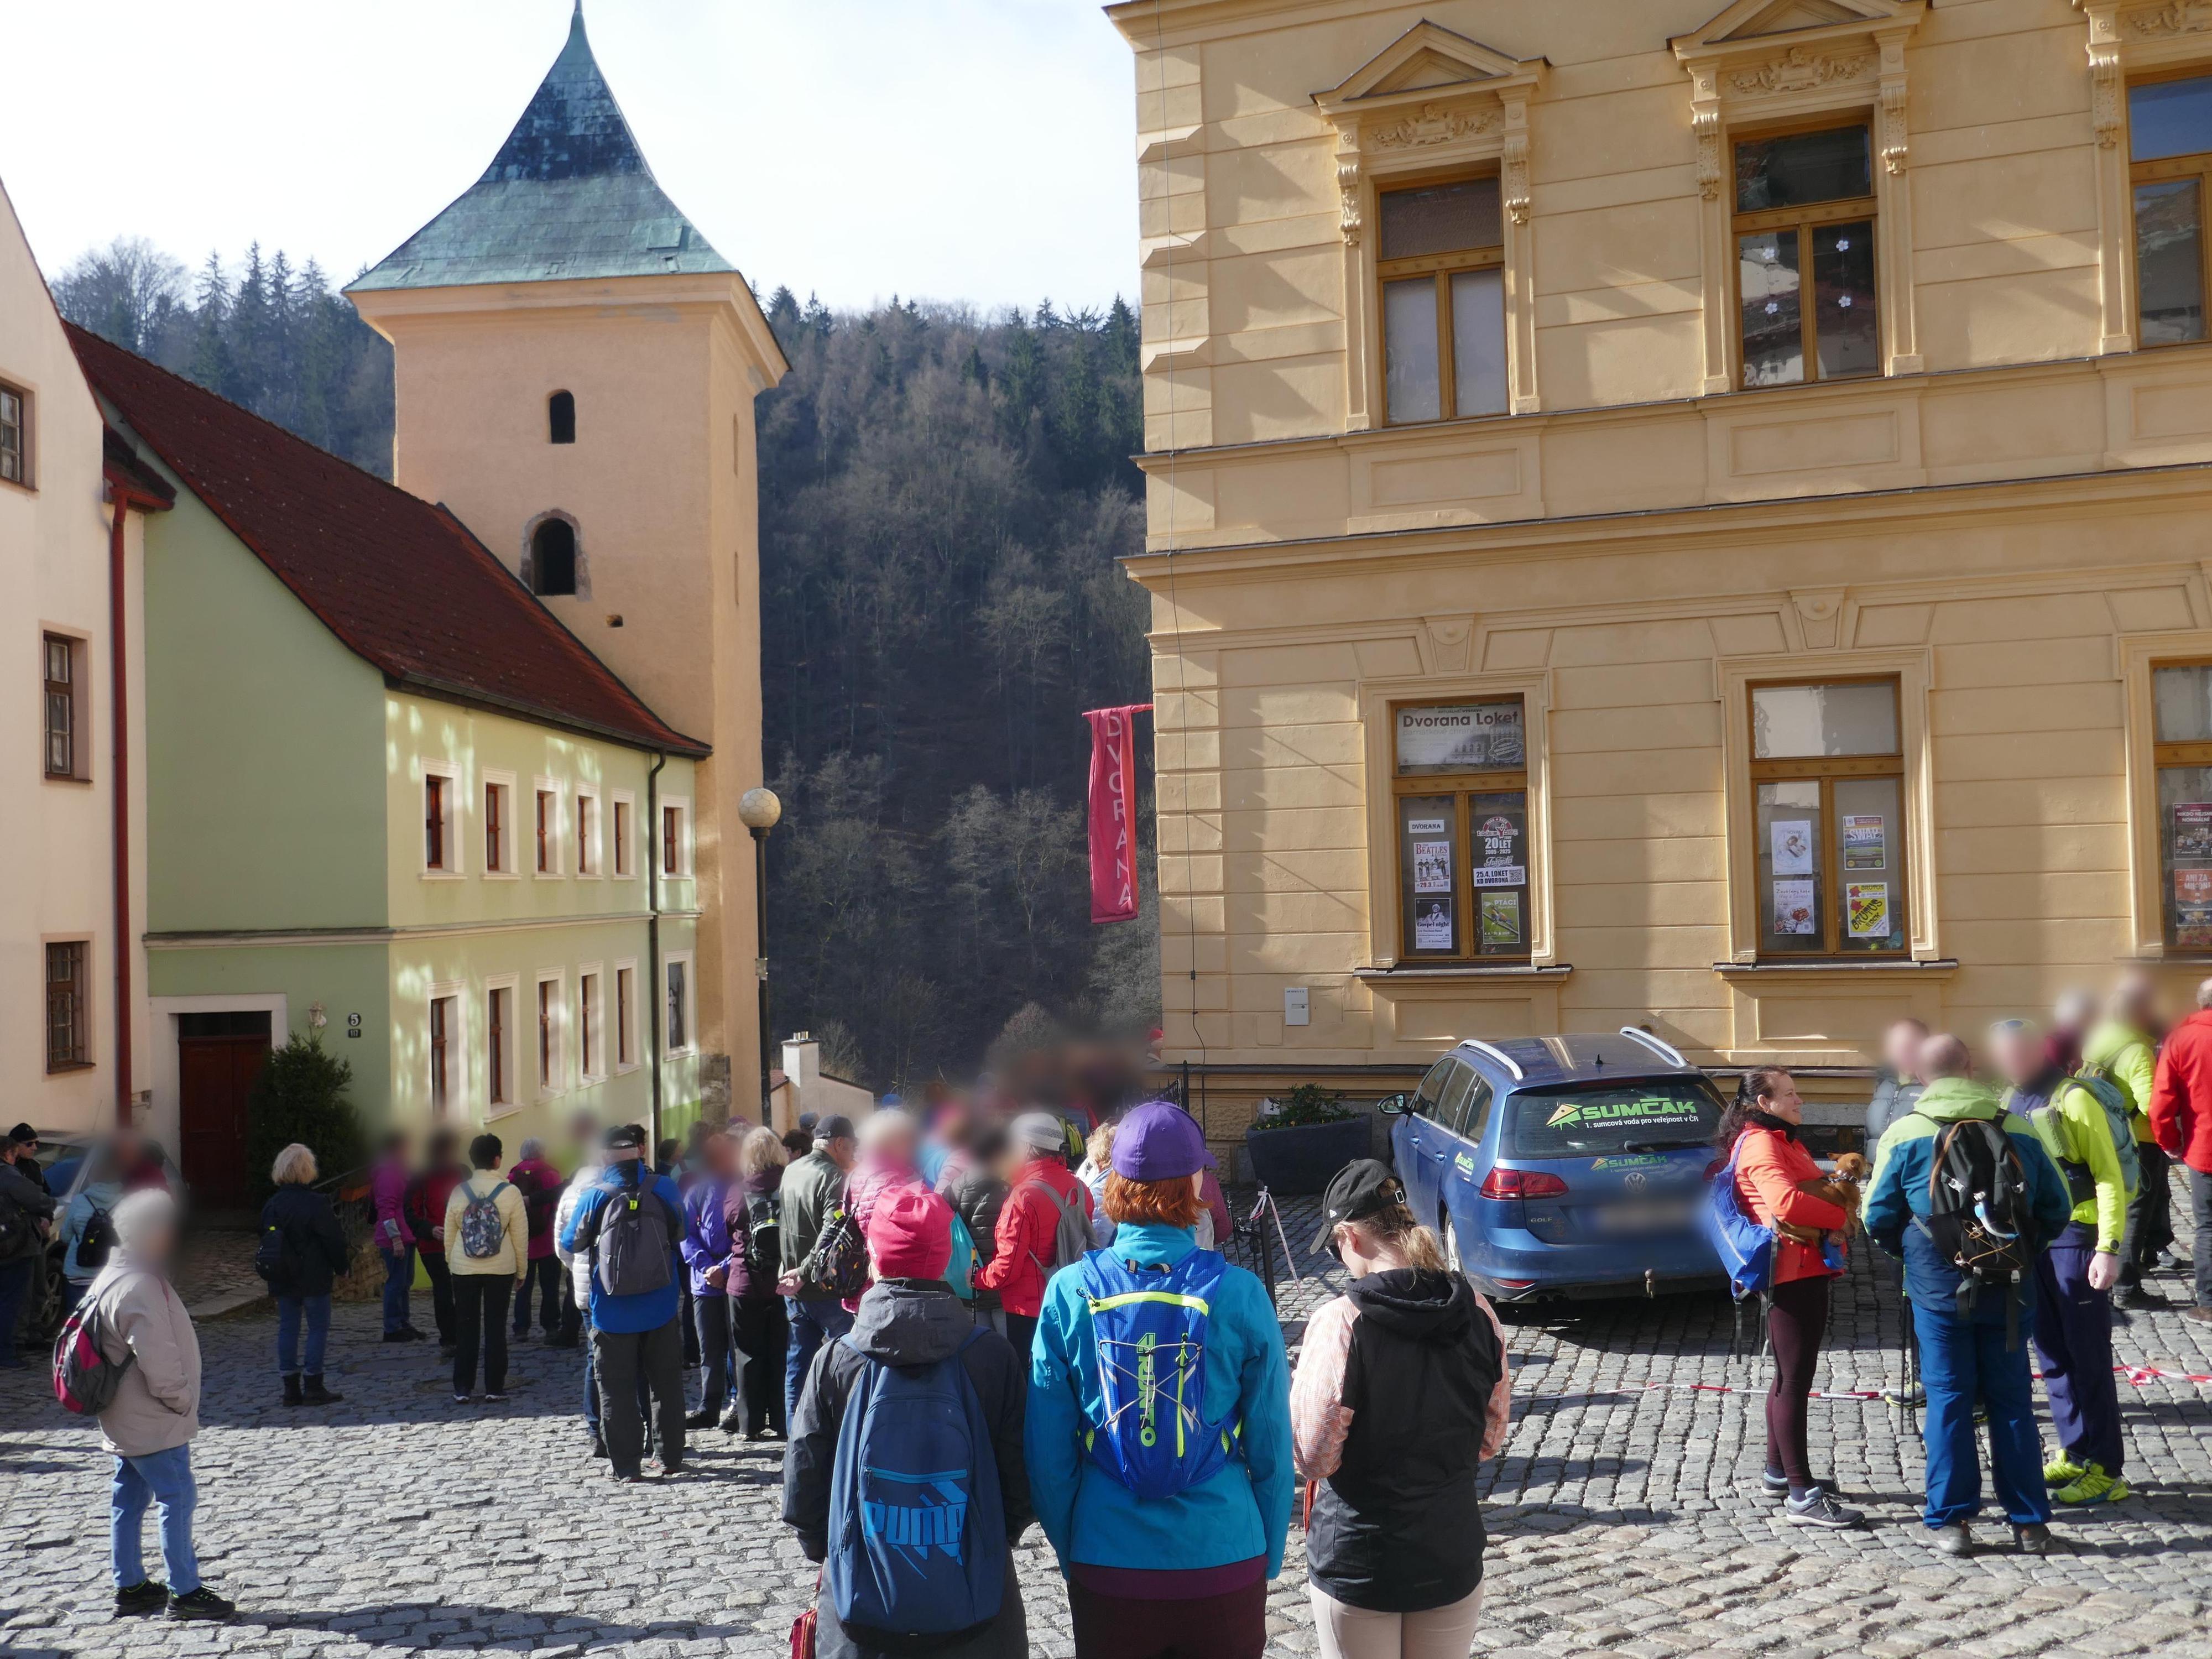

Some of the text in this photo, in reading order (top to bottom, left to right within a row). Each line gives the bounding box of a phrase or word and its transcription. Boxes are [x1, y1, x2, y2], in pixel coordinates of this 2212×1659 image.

[1403, 711, 1518, 727] Dvorana Loket
[1416, 843, 1447, 857] BEATLES
[1485, 837, 1512, 849] 20 LET
[1851, 899, 1882, 930] BRUTUS
[1865, 912, 1881, 927] ROCK
[351, 1014, 359, 1026] 5
[1582, 1098, 1697, 1120] SUMČAK
[1593, 1119, 1623, 1128] sumcová
[1623, 1116, 1640, 1125] voda
[1641, 1118, 1652, 1126] pro
[1652, 1115, 1683, 1125] veřejnost
[1689, 1114, 1699, 1123] ČR
[864, 1500, 967, 1546] PUMA
